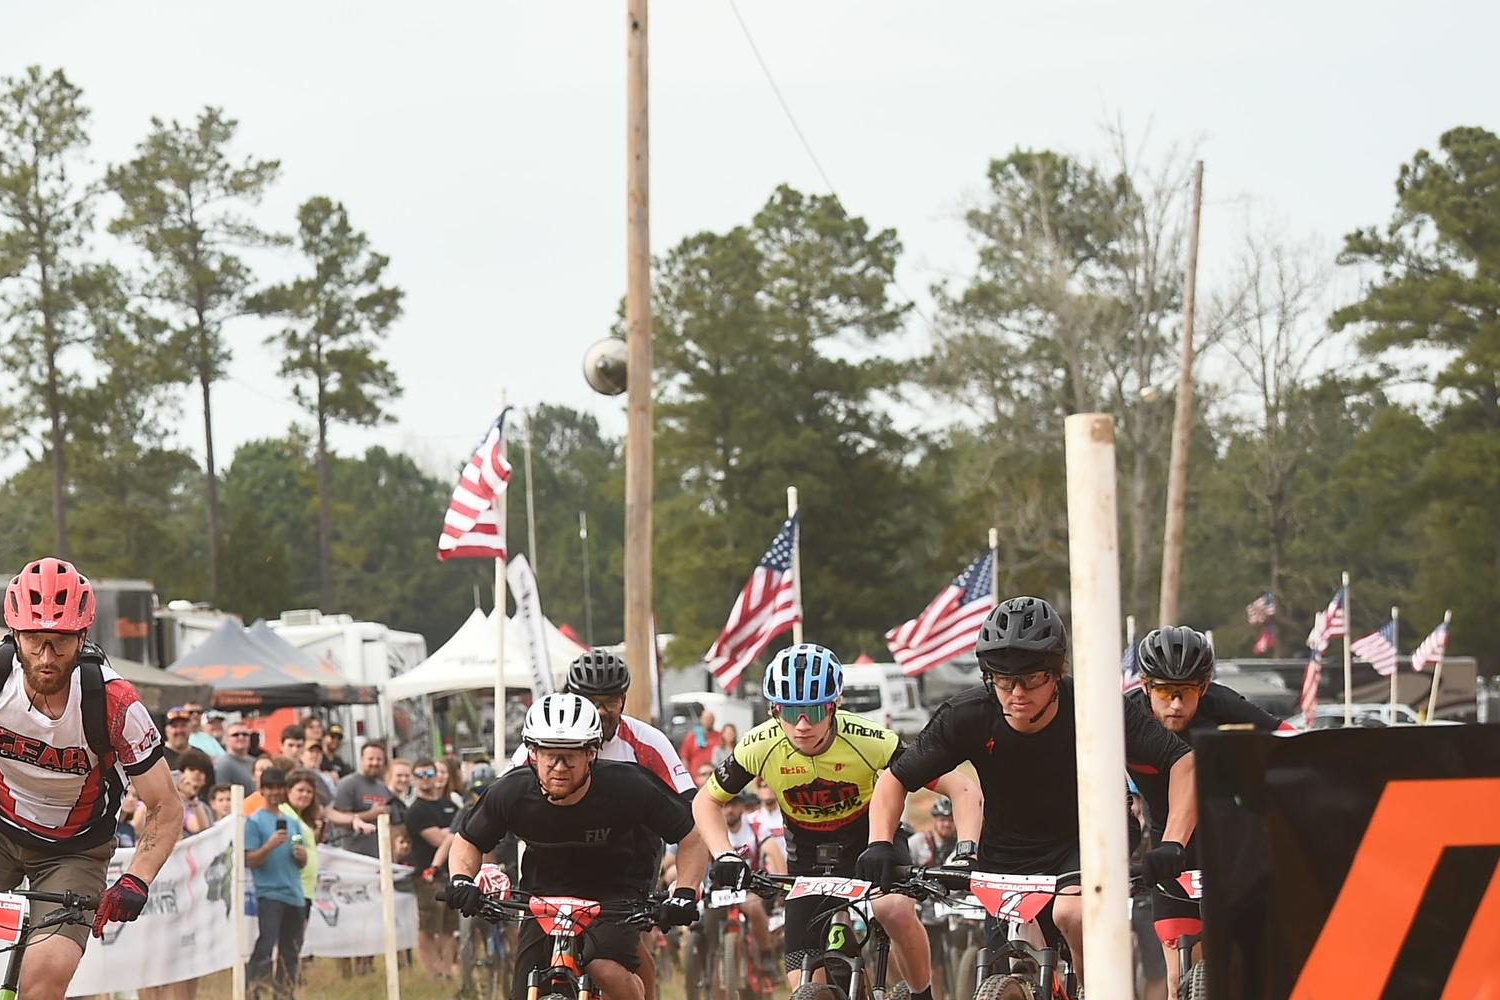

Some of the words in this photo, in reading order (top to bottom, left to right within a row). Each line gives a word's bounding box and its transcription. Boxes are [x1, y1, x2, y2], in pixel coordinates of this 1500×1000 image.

[743, 731, 766, 748] LIVE
[768, 725, 780, 740] IT
[842, 717, 886, 740] XTREME
[585, 827, 612, 842] FLY
[999, 890, 1021, 917] 2
